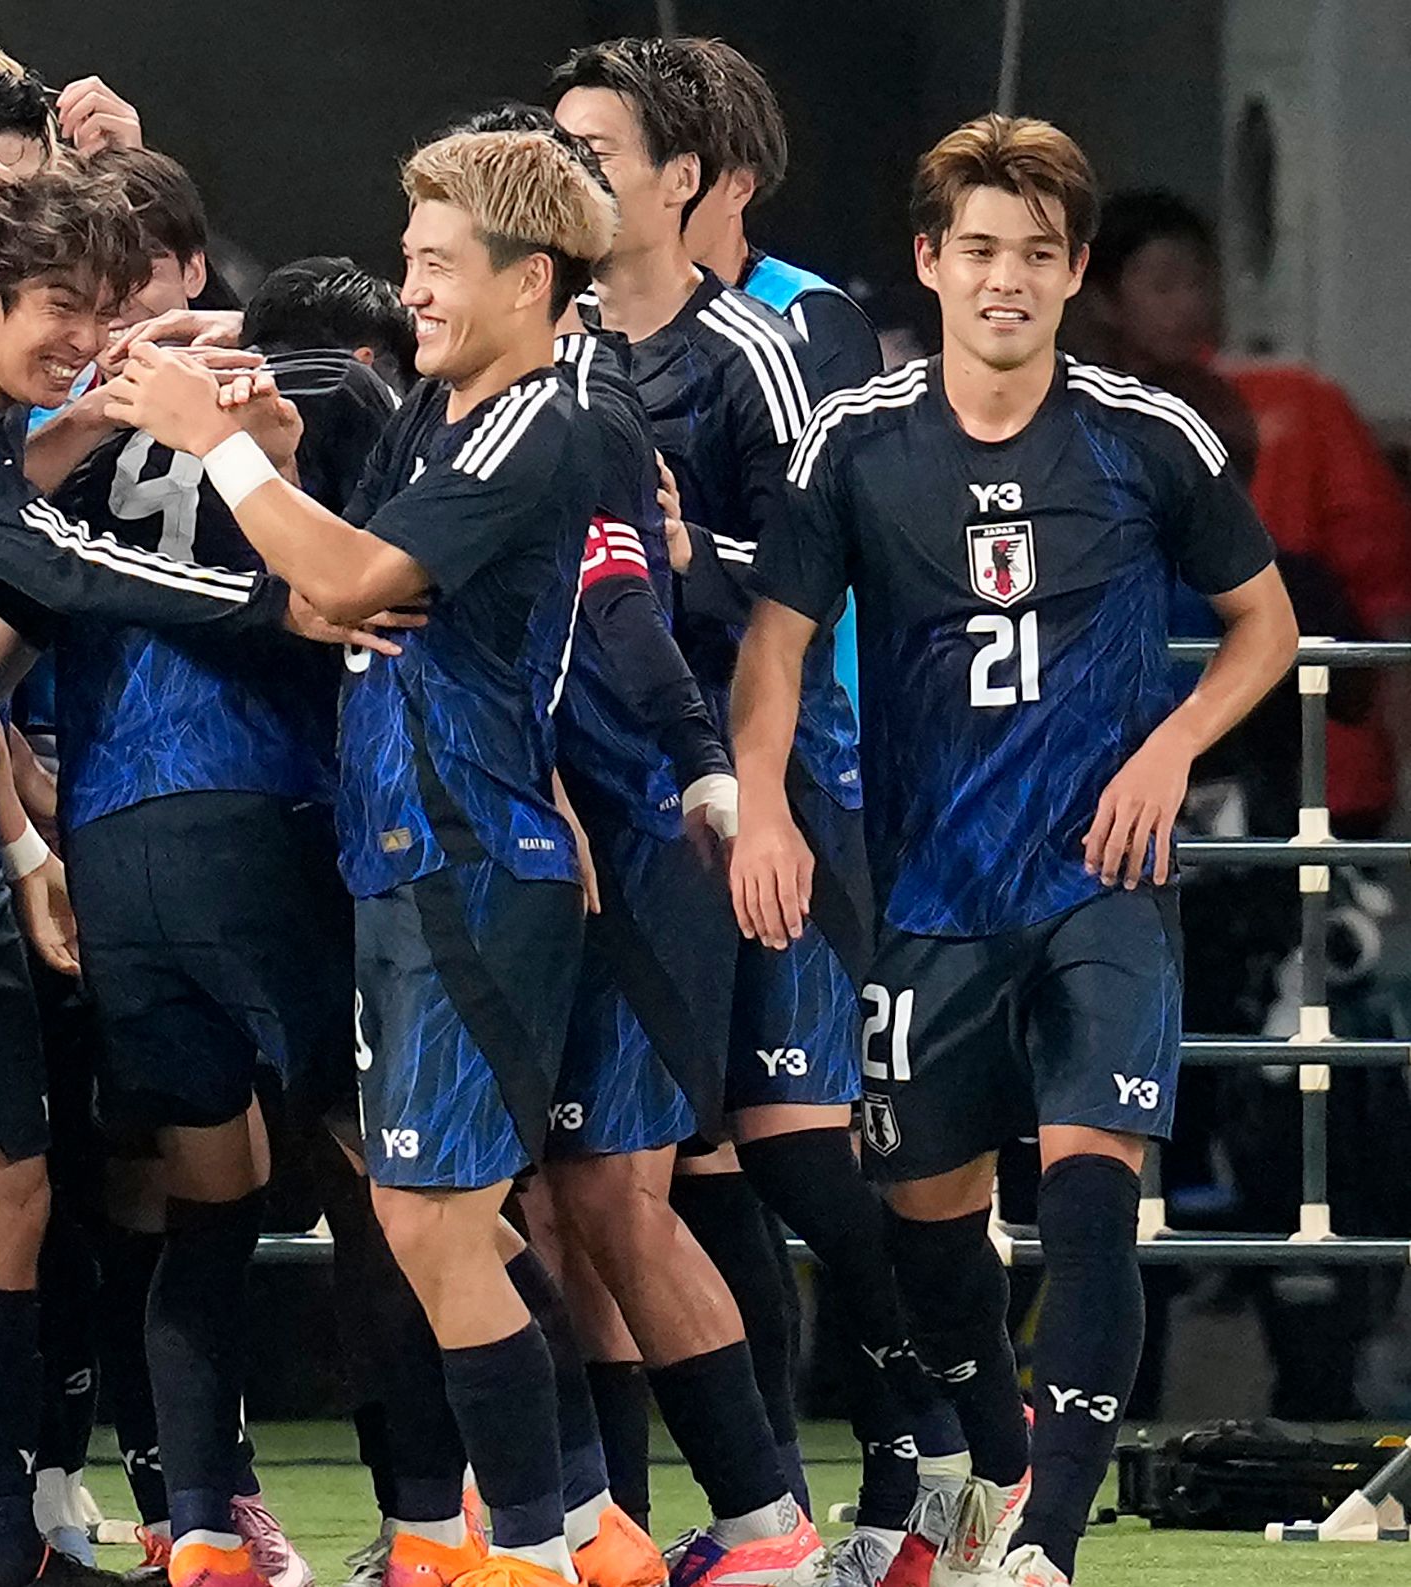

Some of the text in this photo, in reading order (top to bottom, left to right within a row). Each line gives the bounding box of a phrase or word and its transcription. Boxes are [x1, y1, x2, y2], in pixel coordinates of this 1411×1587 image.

[969, 482, 1023, 512] Y-3
[982, 526, 1017, 537] JAPAN
[966, 610, 1041, 707] 21
[861, 983, 915, 1081] 21
[756, 1048, 809, 1078] Y-3
[1112, 1073, 1160, 1110] Y-3
[546, 1102, 584, 1131] Y-3
[381, 1128, 420, 1159] Y-3
[1047, 1384, 1119, 1423] Y-3
